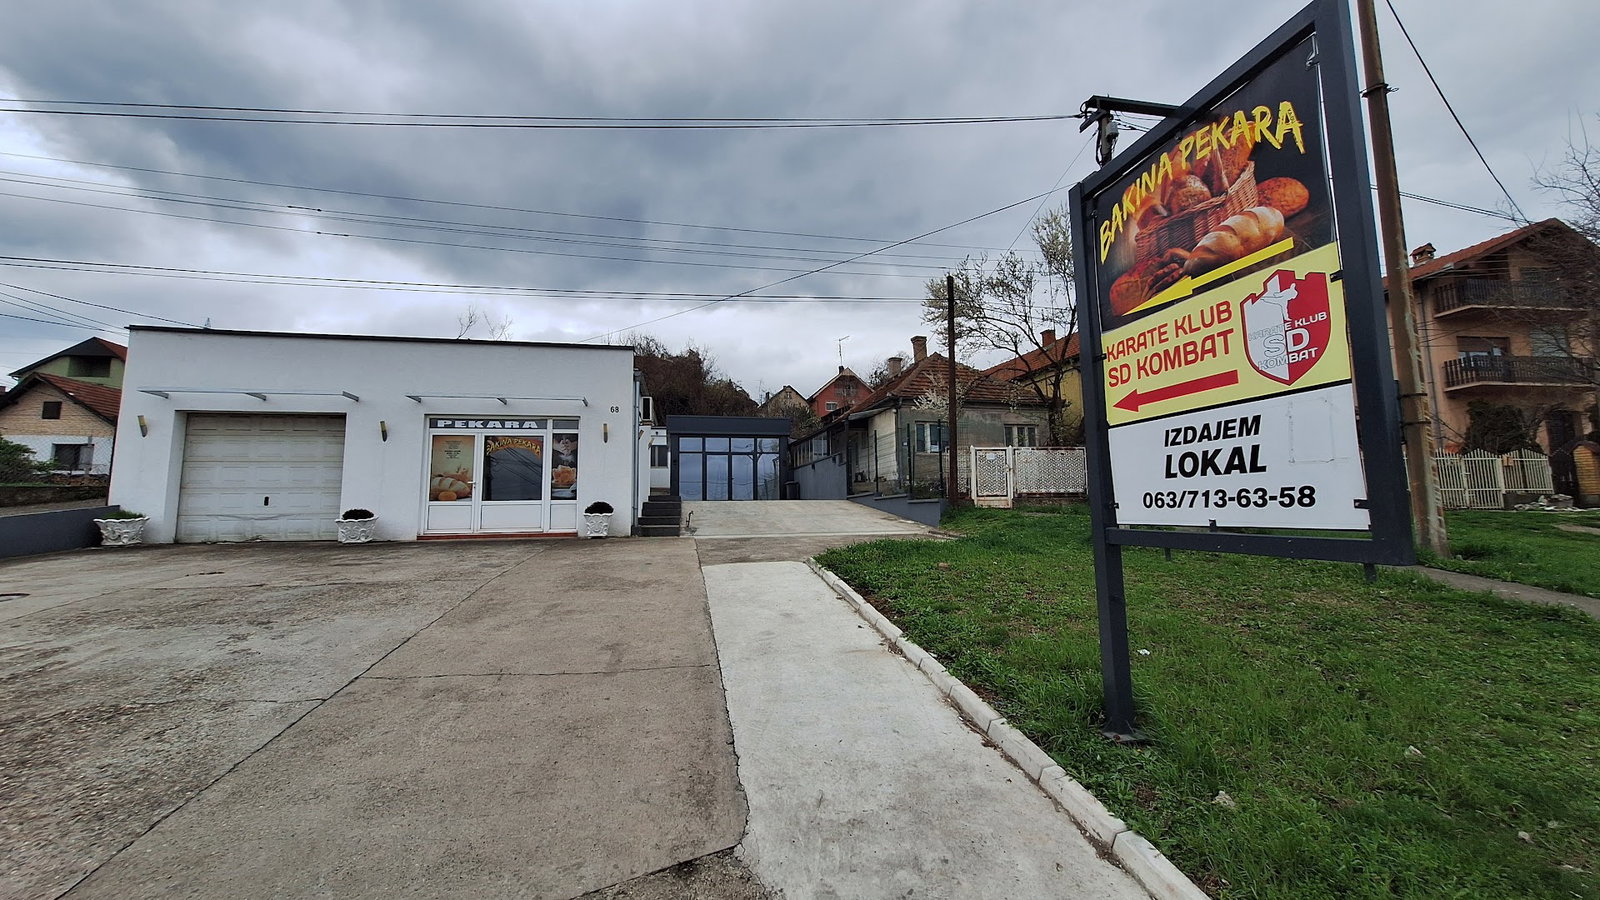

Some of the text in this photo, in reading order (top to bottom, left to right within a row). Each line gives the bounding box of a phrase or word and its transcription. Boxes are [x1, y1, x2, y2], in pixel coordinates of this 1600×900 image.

[1099, 101, 1306, 265] BAKINA PEKARA
[1106, 300, 1233, 362] KARATE KLUB
[1294, 311, 1327, 328] KLUB
[1108, 328, 1234, 388] SD KOMBAT
[1263, 328, 1310, 358] SD
[1257, 347, 1318, 370] KOMBAT
[436, 419, 539, 429] PEKARA
[610, 405, 620, 414] 68
[1164, 414, 1261, 447] IZDAJEM
[1164, 444, 1267, 479] LOKAL
[1142, 485, 1316, 509] 063/713-63-58
